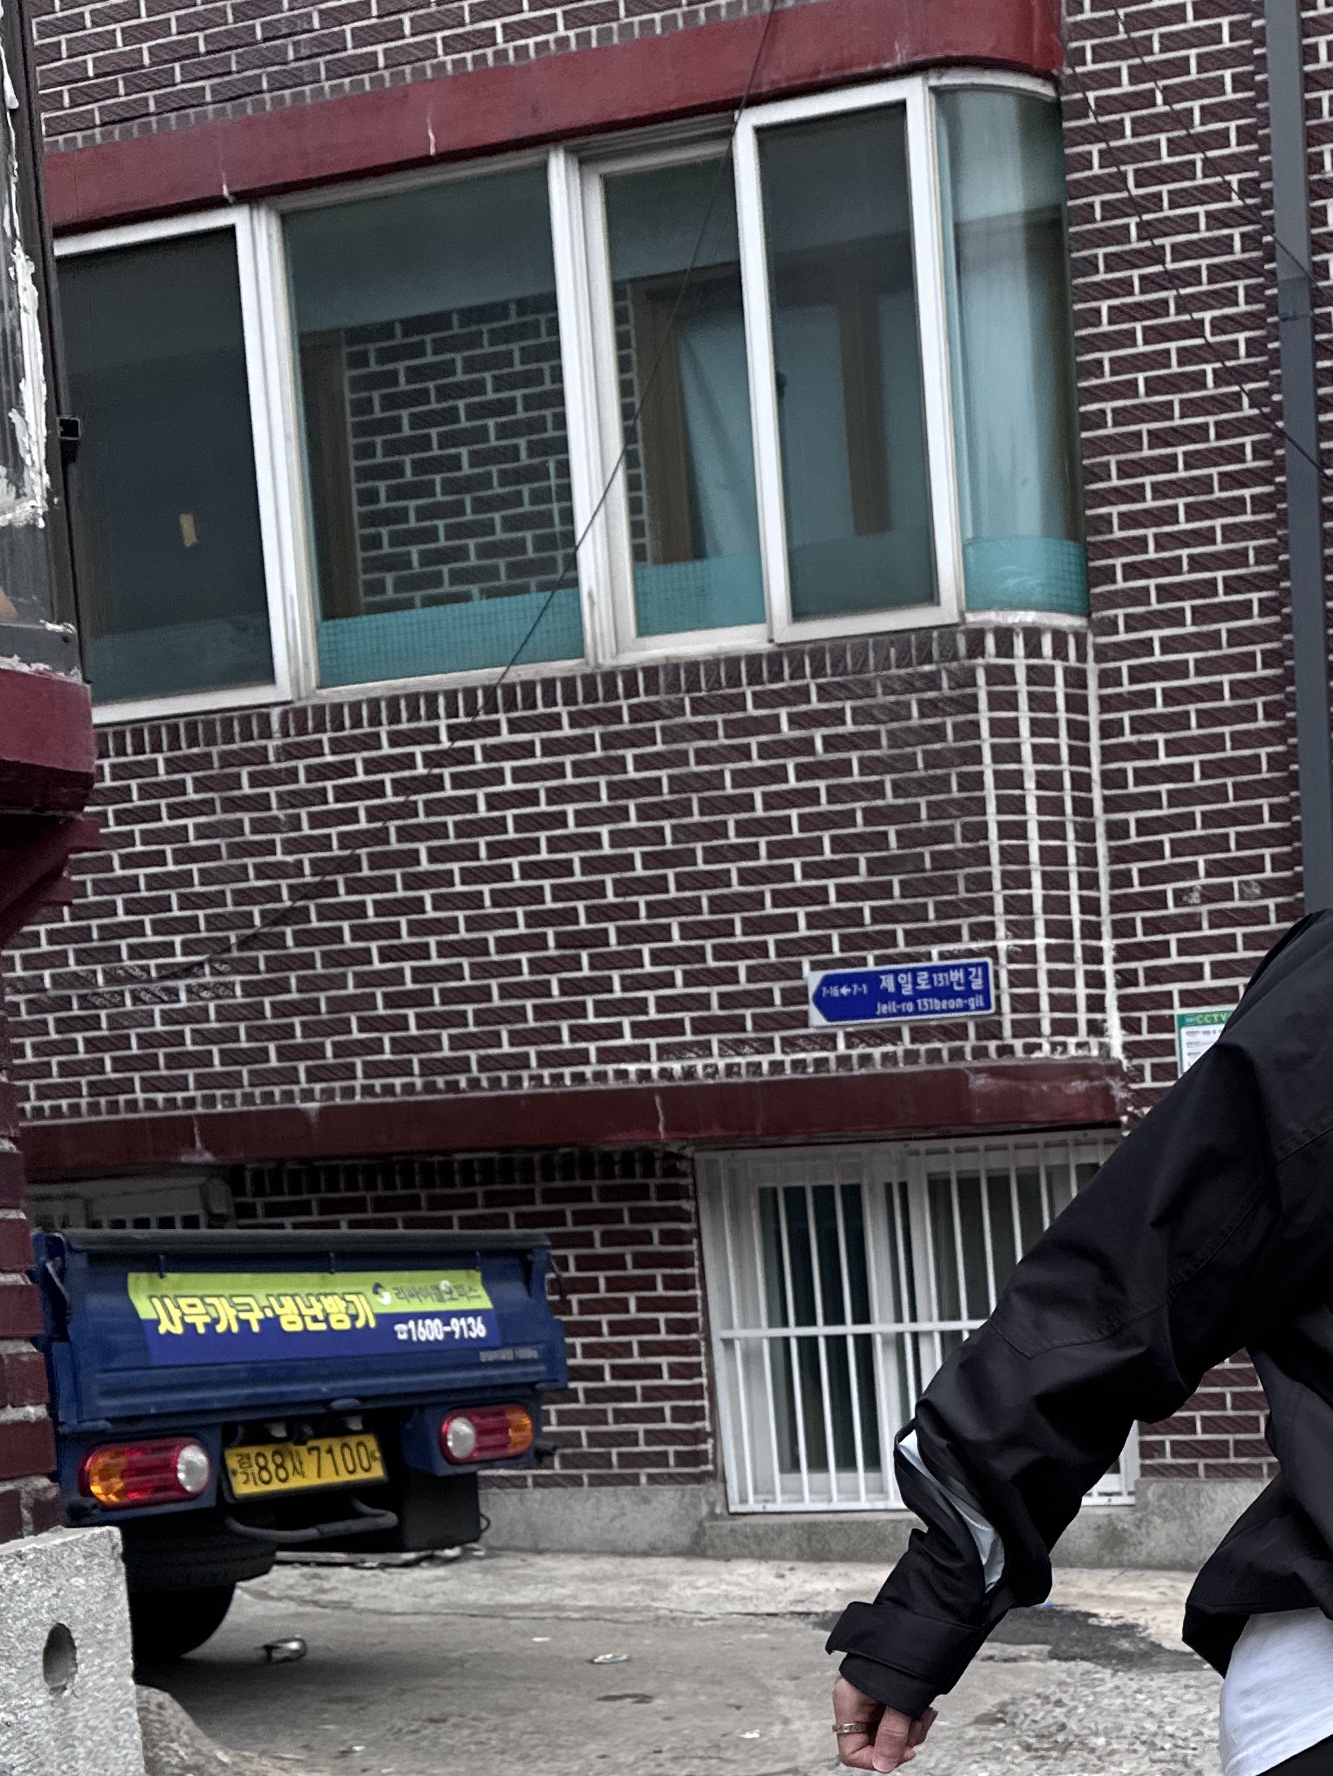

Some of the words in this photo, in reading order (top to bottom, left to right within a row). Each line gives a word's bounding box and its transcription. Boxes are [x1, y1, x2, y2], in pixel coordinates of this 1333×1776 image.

[875, 1000, 915, 1016] Jeil-ro
[407, 1315, 487, 1342] 1600-9136
[307, 1441, 373, 1479] 7100
